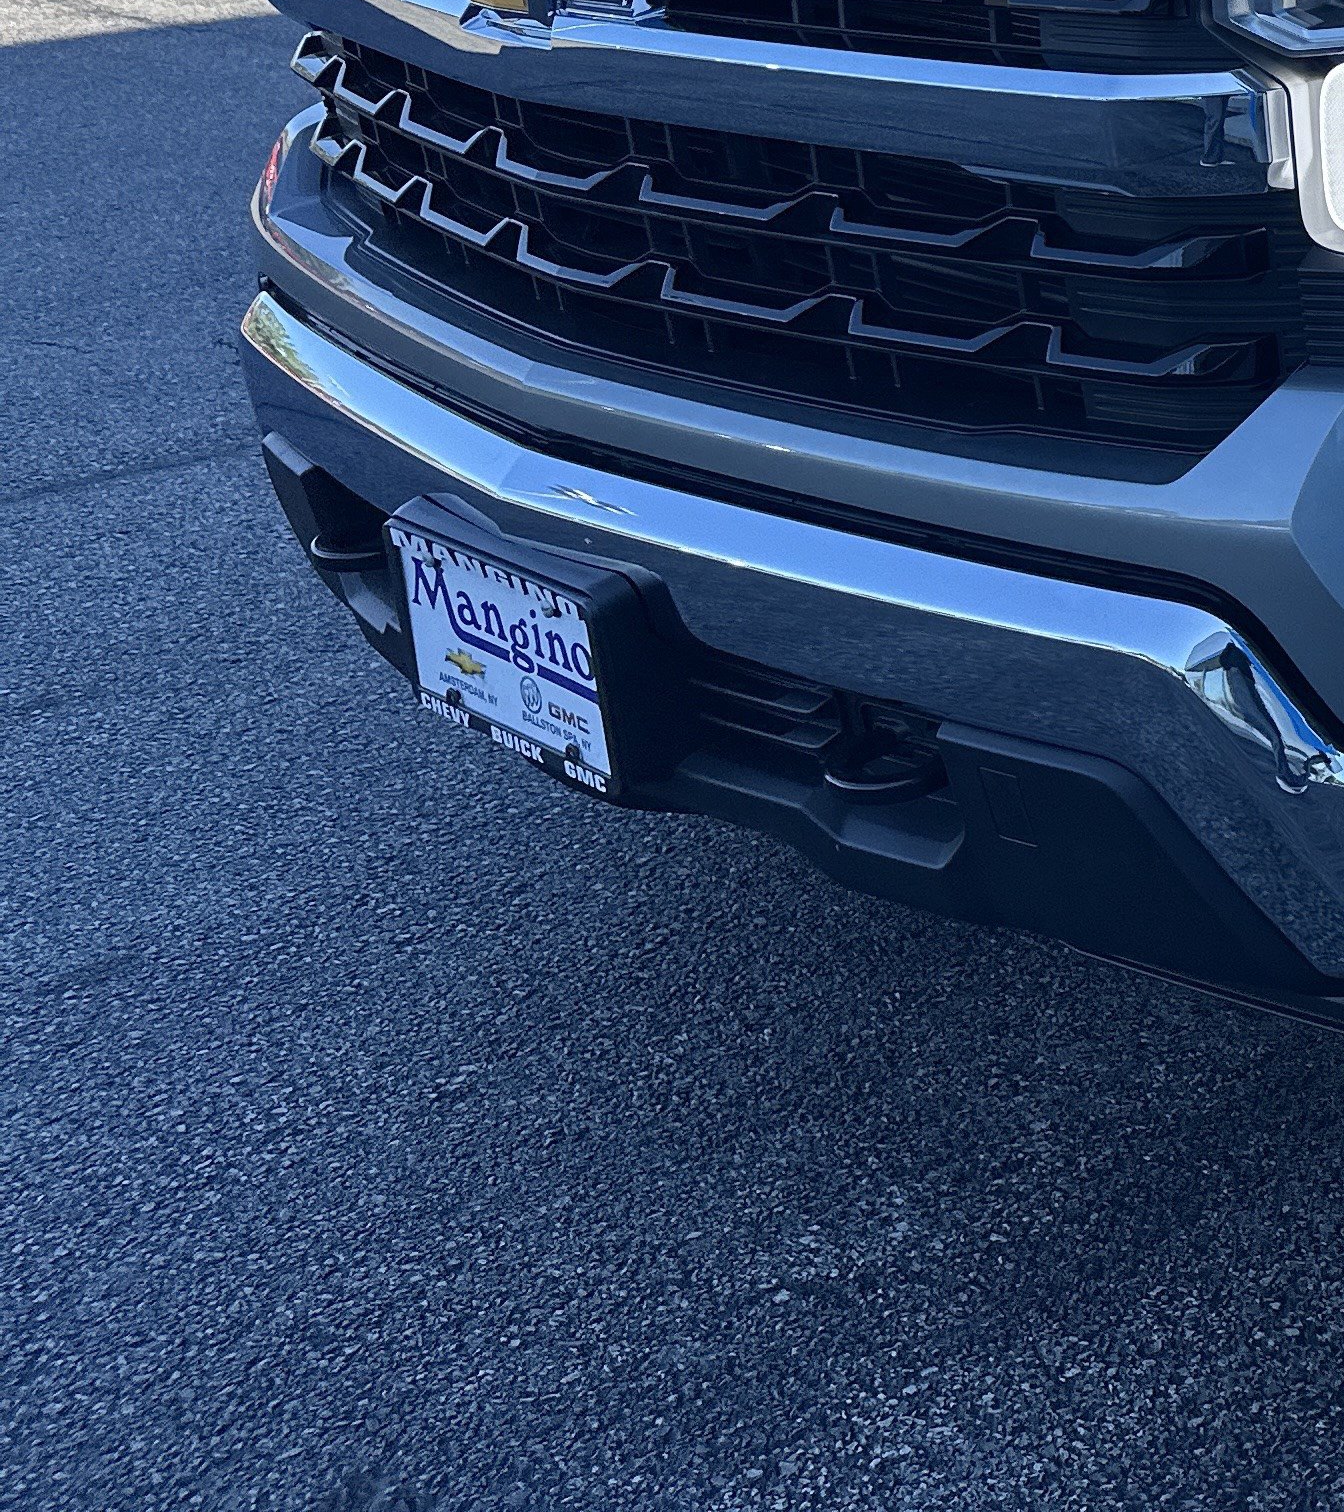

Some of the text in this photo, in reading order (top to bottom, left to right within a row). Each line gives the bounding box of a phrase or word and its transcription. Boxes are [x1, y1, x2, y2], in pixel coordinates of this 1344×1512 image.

[411, 554, 597, 683] Mangino
[487, 694, 499, 707] NY
[547, 700, 591, 736] GMC
[420, 691, 608, 793] CHEVY BUICK GMC
[521, 709, 563, 739] BALLSTON
[581, 739, 592, 753] NY
